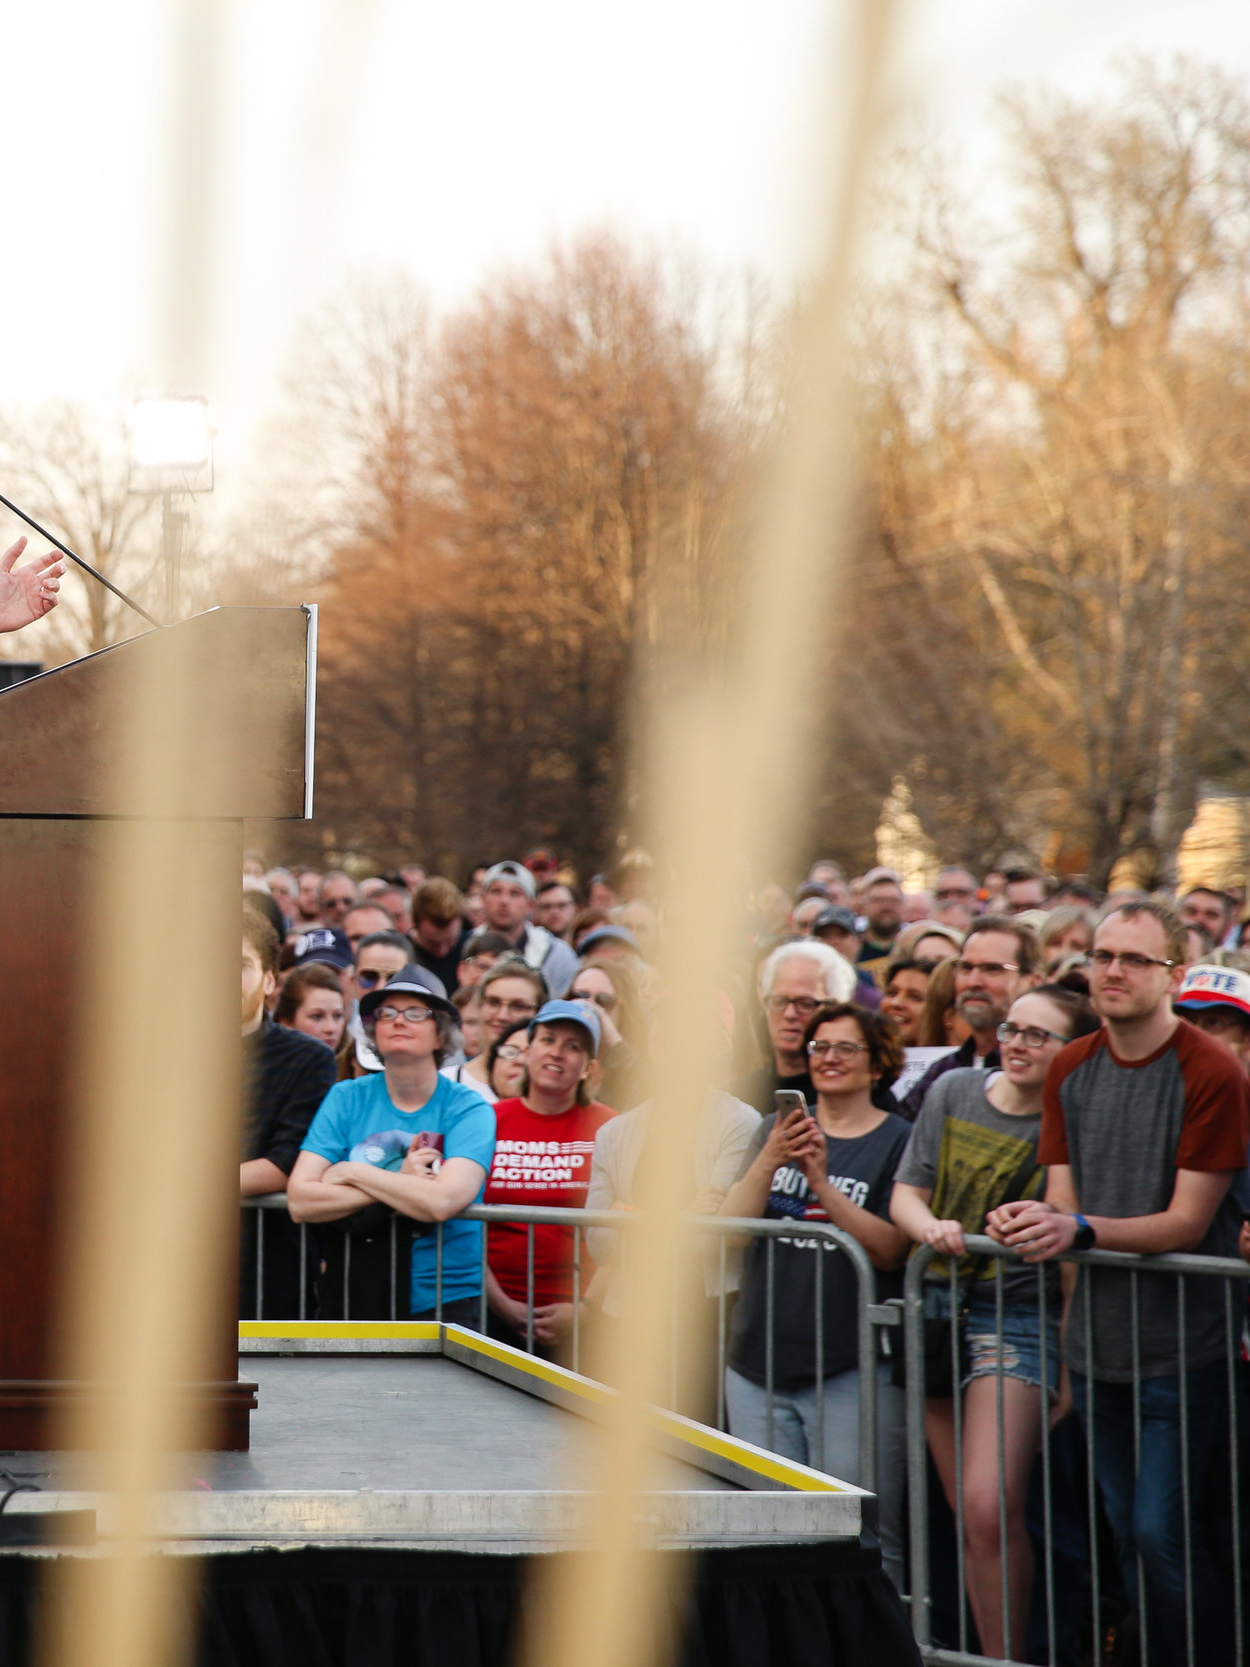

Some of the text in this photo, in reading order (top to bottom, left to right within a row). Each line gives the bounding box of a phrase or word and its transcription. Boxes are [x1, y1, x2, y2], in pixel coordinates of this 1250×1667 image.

[1187, 970, 1238, 992] VOTE
[496, 1140, 560, 1154] MOMS
[494, 1154, 584, 1168] DEMAND
[492, 1168, 571, 1180] ACTION
